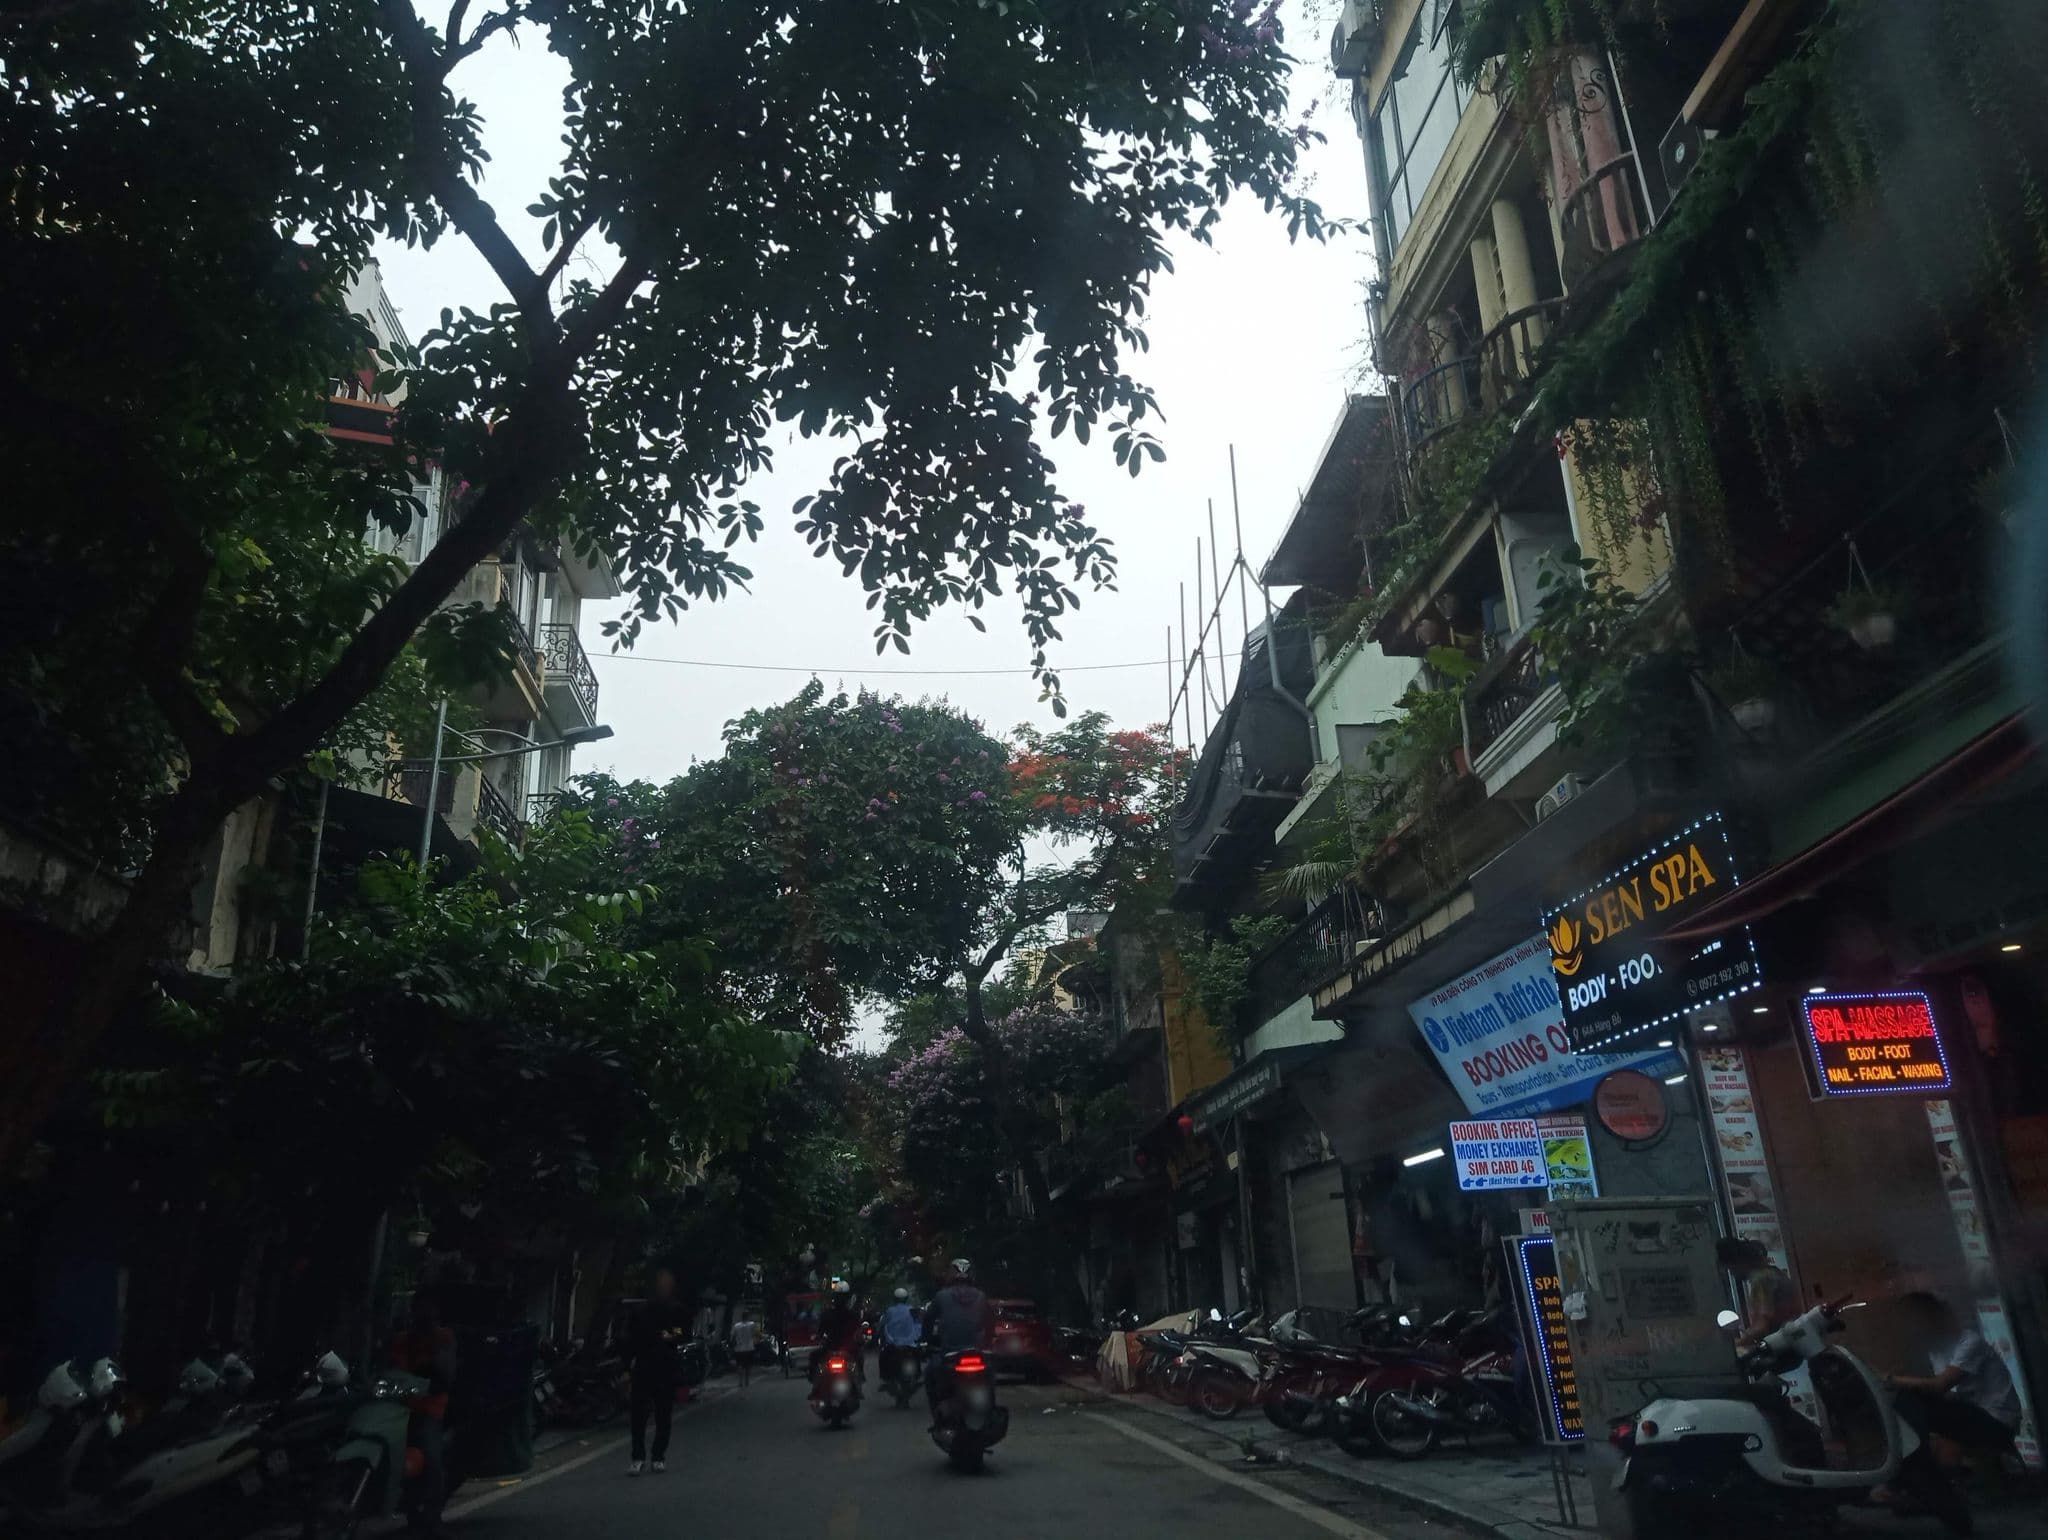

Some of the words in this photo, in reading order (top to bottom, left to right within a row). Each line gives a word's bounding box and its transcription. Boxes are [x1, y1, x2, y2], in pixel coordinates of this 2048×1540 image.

[1585, 876, 1645, 944] SEN
[1649, 843, 1716, 912] SPA
[1567, 973, 1607, 1012] BODY
[1442, 1002, 1505, 1047] Vietnam
[1494, 975, 1560, 1025] Buffalo
[1462, 1033, 1549, 1087] BOOKING
[1847, 1047, 1876, 1061] BODY
[1884, 1045, 1911, 1058] FOOT
[1558, 1063, 1578, 1078] Sim
[1576, 1055, 1601, 1073] Card
[1828, 1068, 1853, 1082] NAIL
[1859, 1065, 1896, 1080] FACIAL
[1901, 1063, 1943, 1078] WAXING
[1452, 1123, 1499, 1142] BOOKING
[1502, 1120, 1537, 1140] OFFICE
[1555, 1129, 1584, 1137] TREKKING
[1456, 1143, 1489, 1160] MONEY
[1491, 1140, 1540, 1158] EXCHANGE
[1468, 1161, 1489, 1176] SIM
[1491, 1160, 1519, 1175] CARD
[1521, 1159, 1535, 1173] 4G
[1535, 1275, 1560, 1290] SPA
